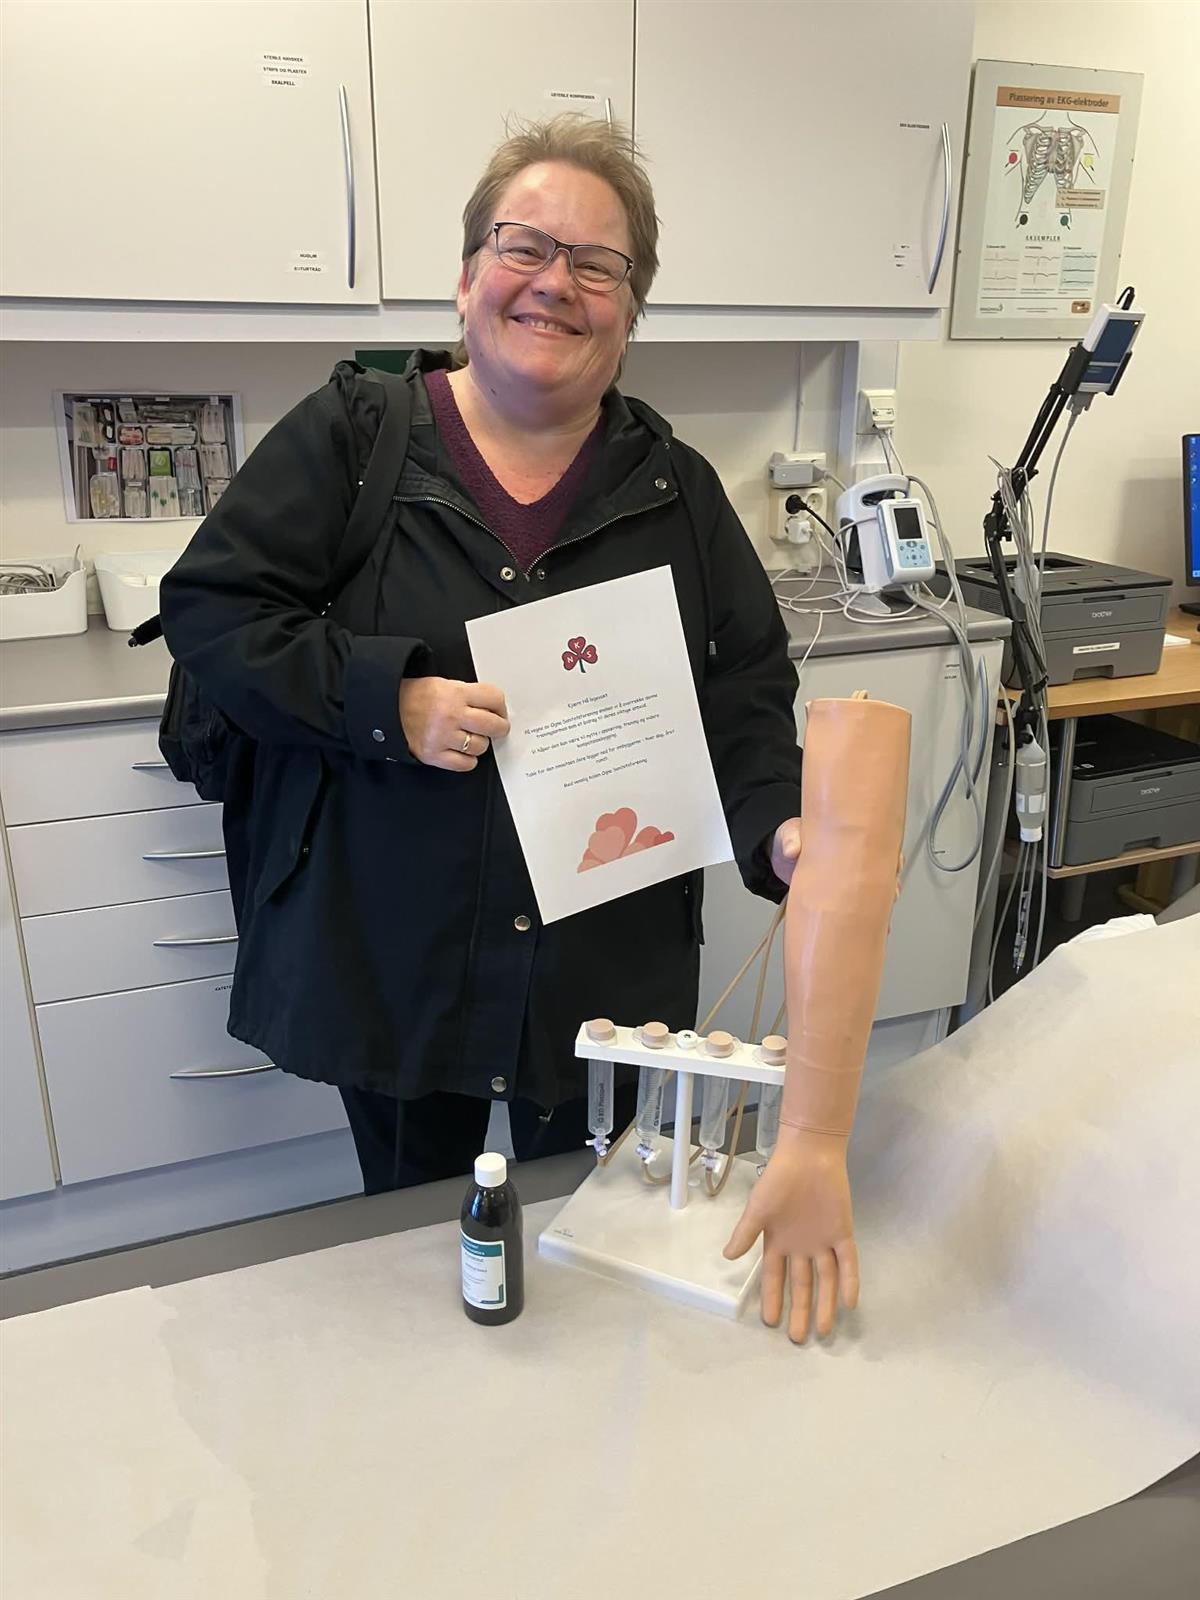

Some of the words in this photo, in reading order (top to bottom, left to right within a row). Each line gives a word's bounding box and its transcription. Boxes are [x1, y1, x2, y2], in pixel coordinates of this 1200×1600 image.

[1009, 93, 1045, 105] Plassering
[1057, 95, 1109, 108] EKG-elektroder
[566, 655, 574, 664] N
[573, 641, 581, 649] K
[586, 650, 593, 659] S
